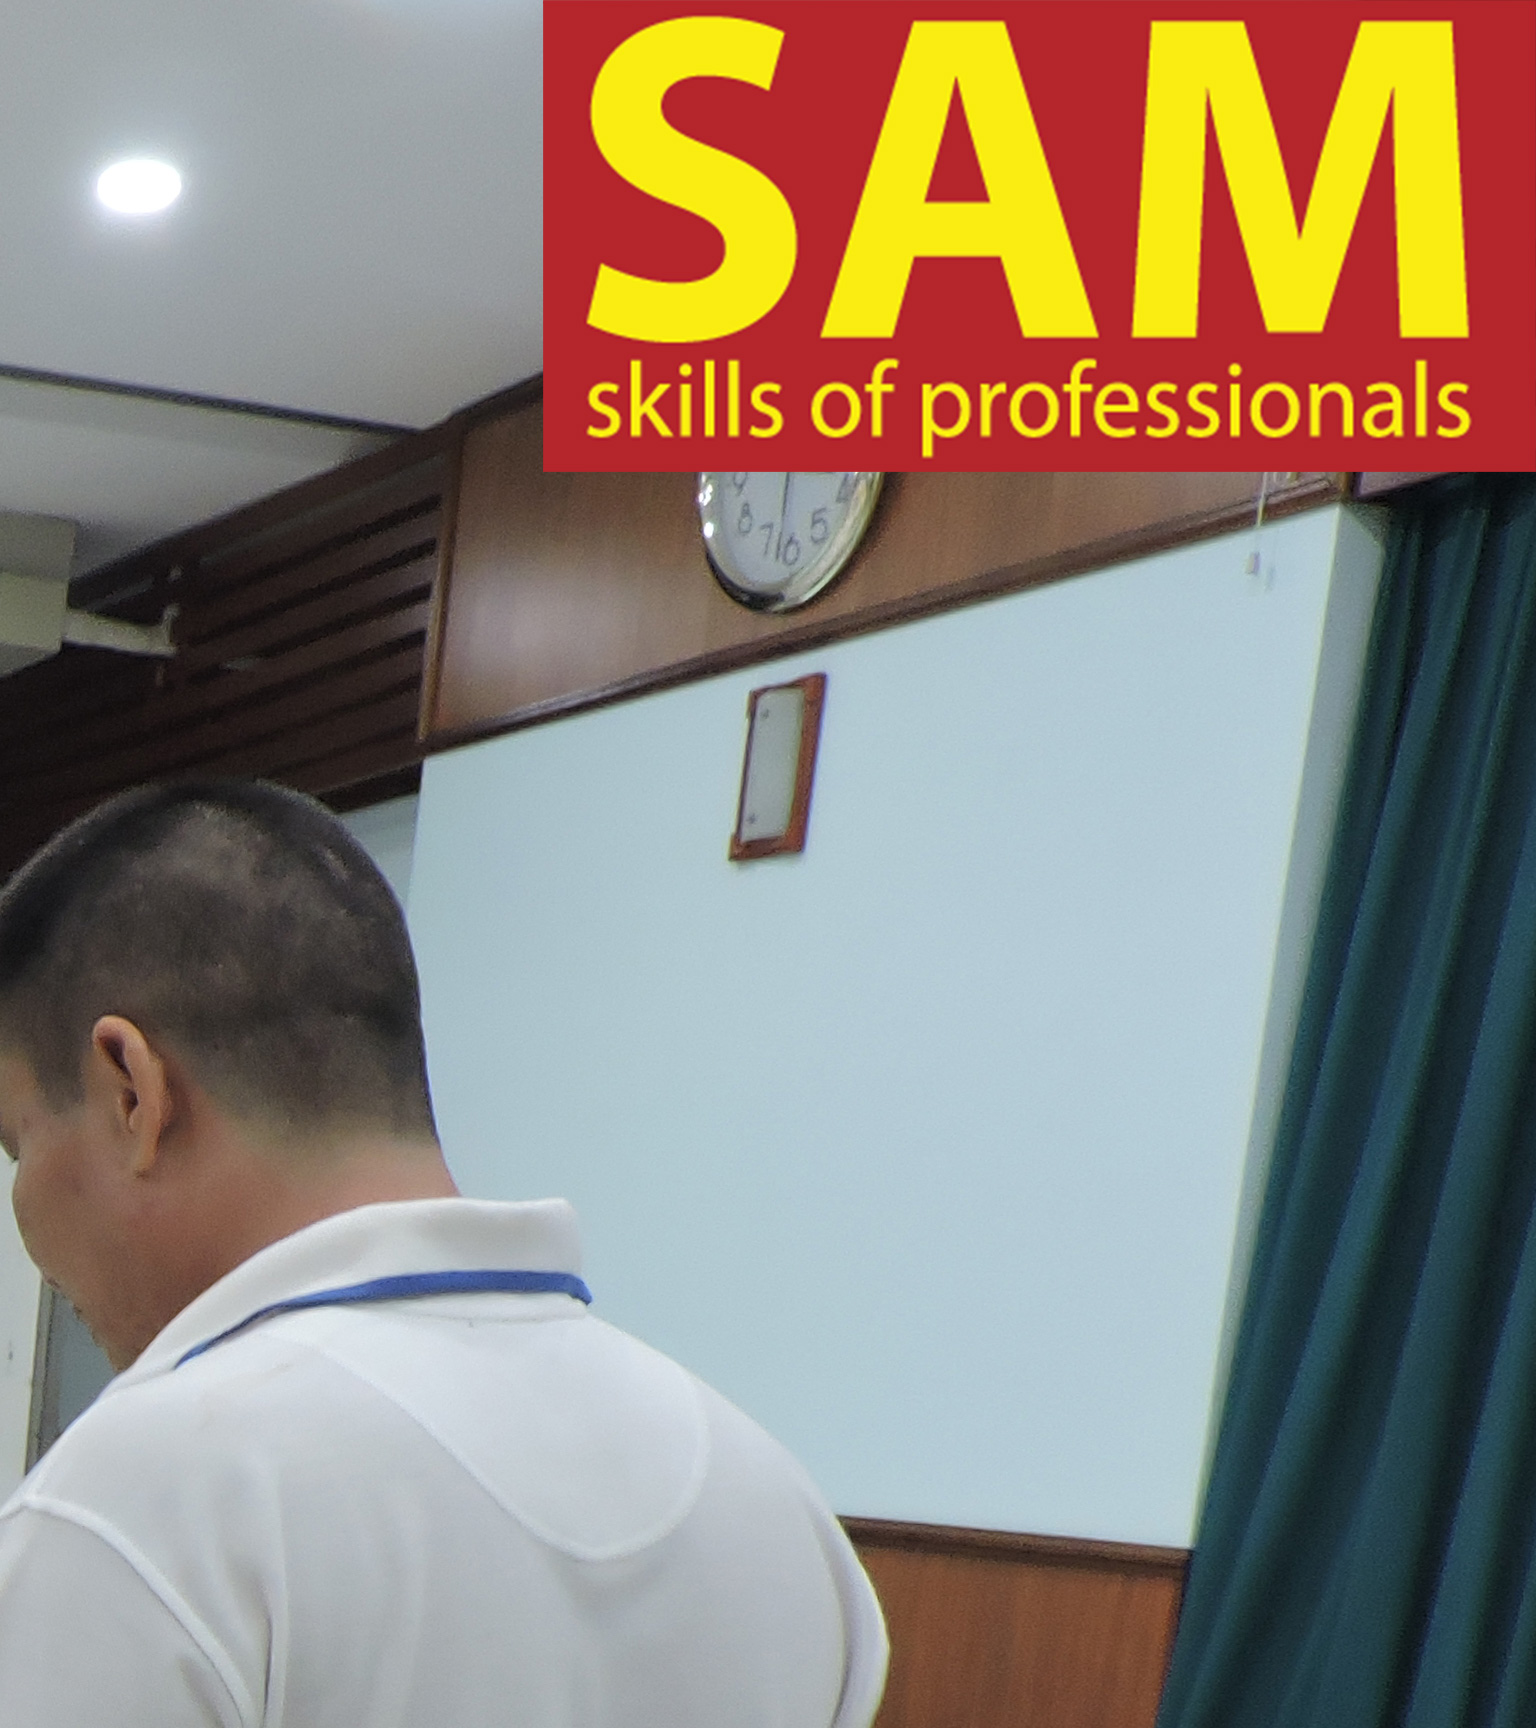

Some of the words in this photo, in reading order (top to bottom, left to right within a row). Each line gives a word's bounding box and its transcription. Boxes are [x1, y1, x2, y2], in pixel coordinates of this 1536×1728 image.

[737, 502, 753, 534] 8
[811, 507, 828, 544] 5
[760, 521, 774, 556] 7
[782, 532, 801, 566] 6
